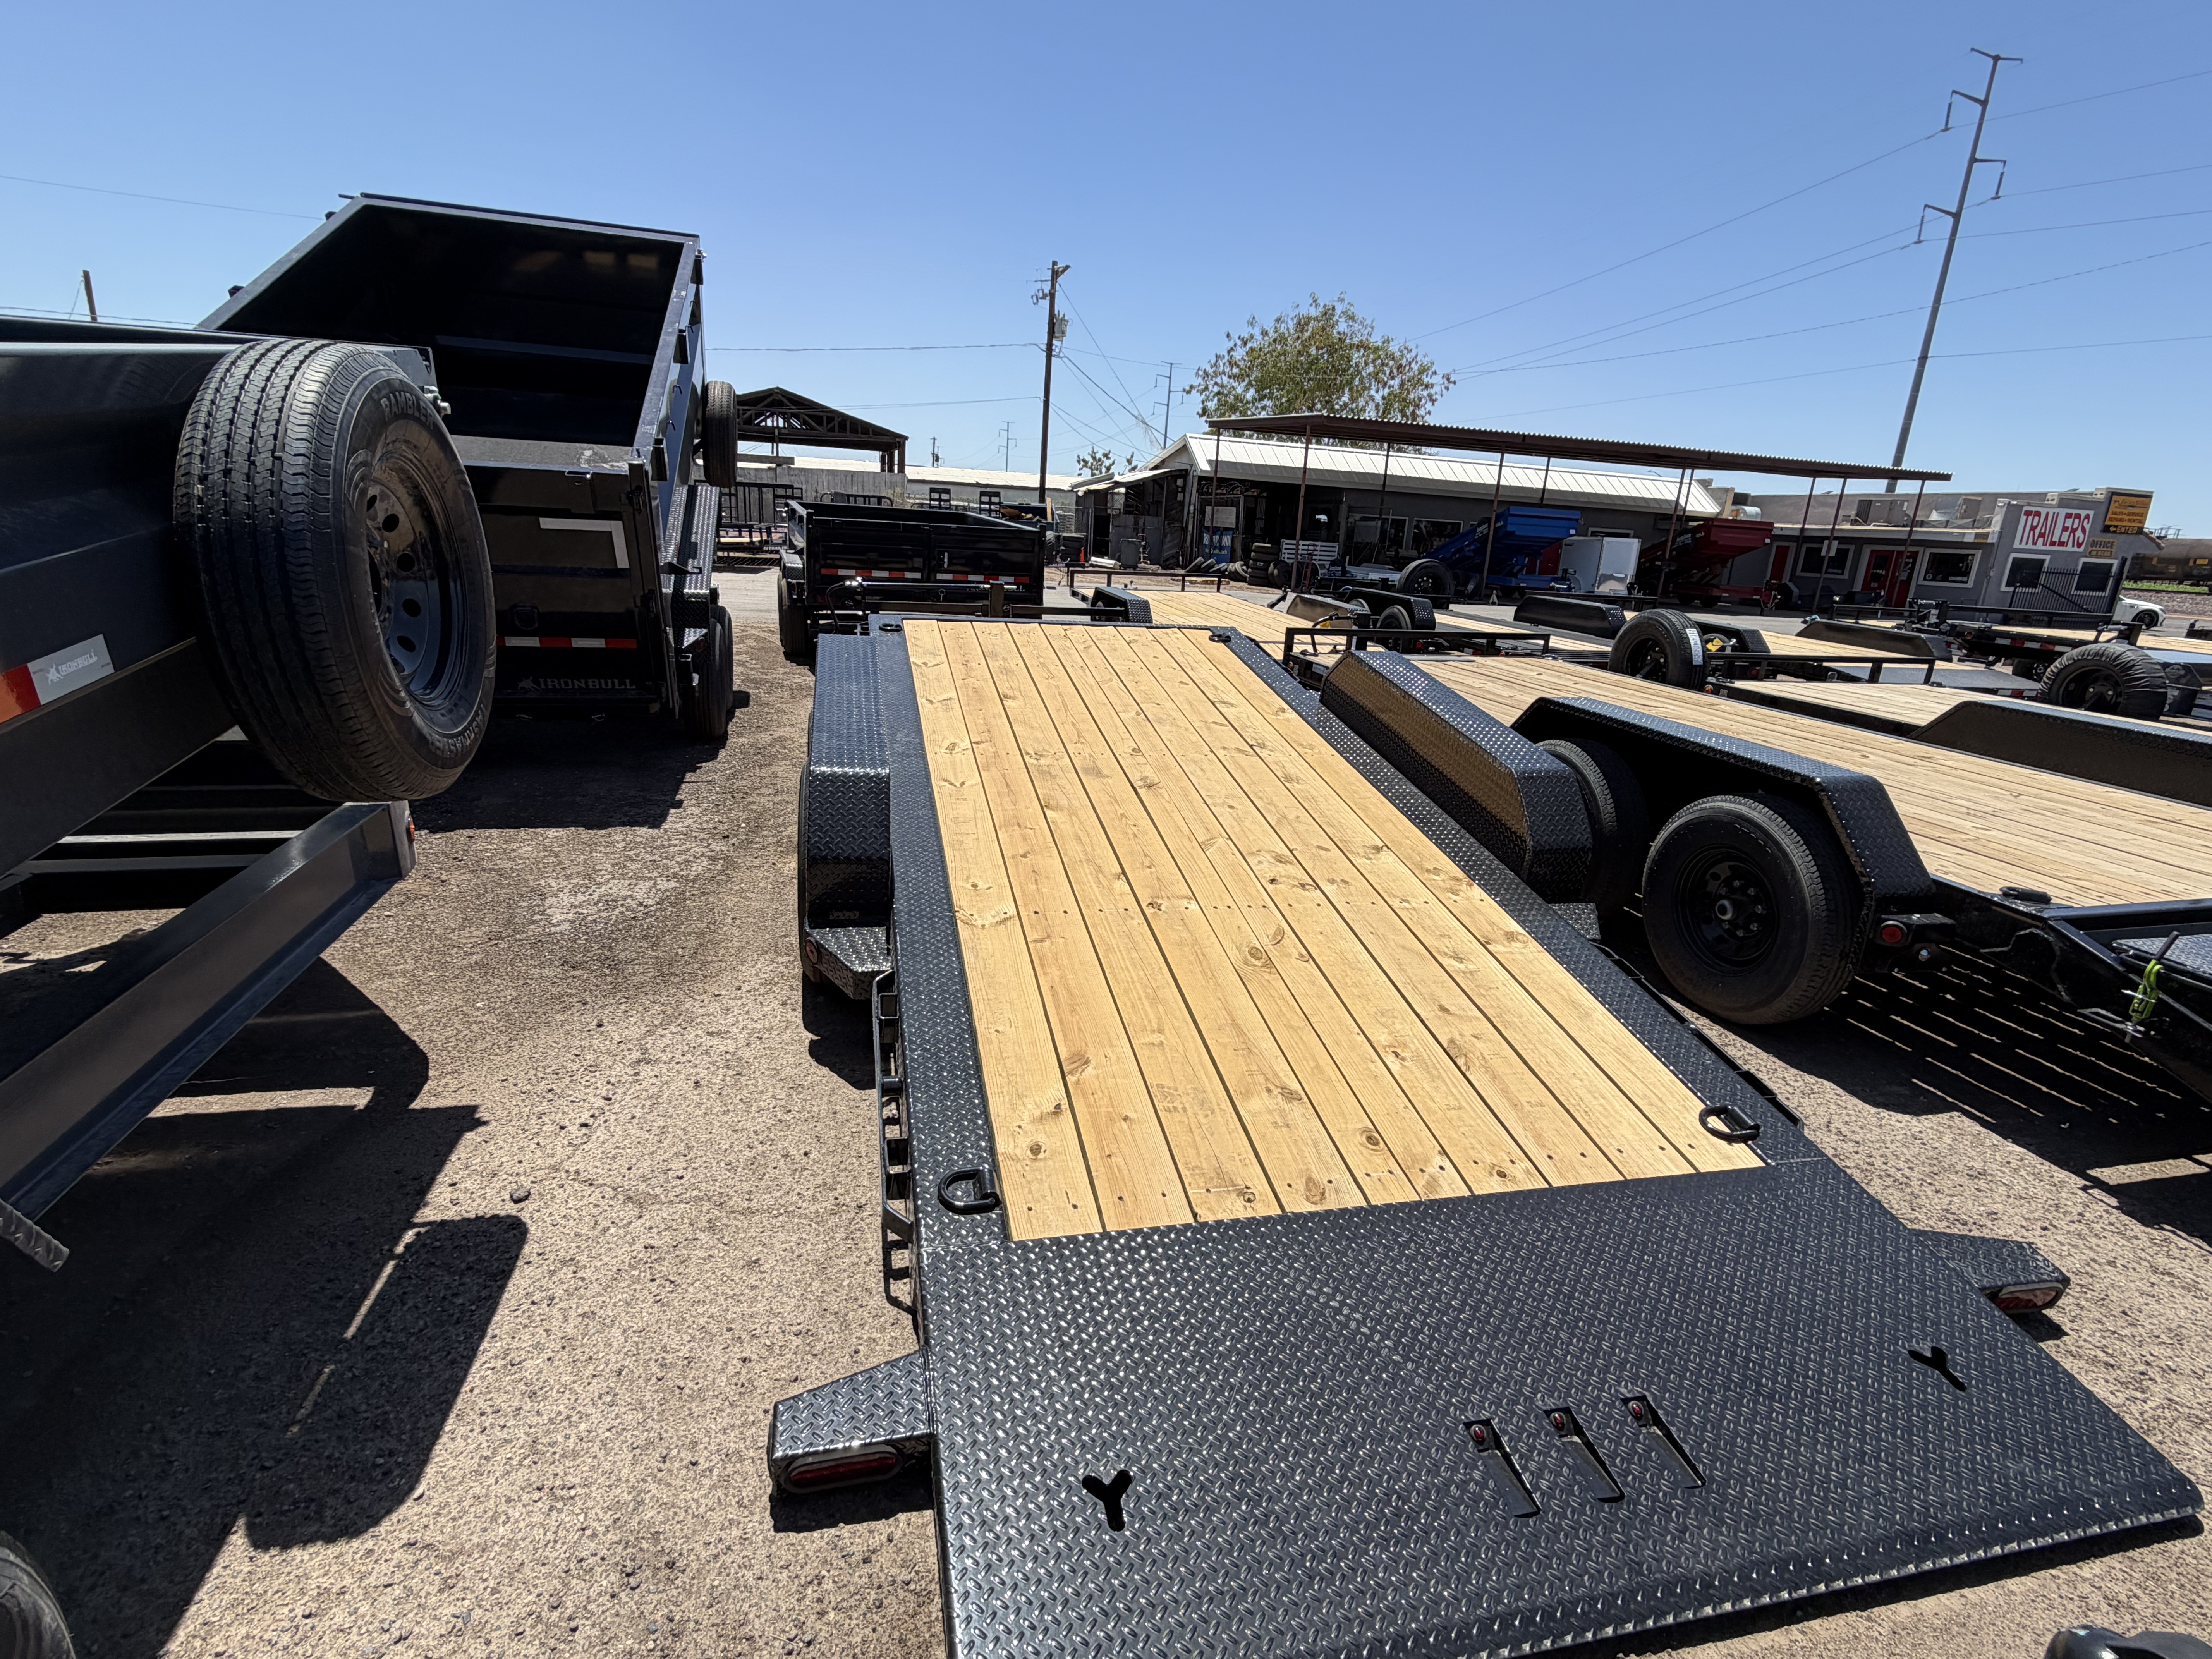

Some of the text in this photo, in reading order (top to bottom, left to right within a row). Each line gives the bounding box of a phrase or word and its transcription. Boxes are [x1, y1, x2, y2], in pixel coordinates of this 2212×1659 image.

[381, 392, 433, 430] RAMBLER
[2019, 510, 2090, 549] TRAILERS
[2090, 539, 2115, 549] OFFICE
[58, 649, 98, 675] IRONBULL
[539, 678, 636, 689] IRONBULL
